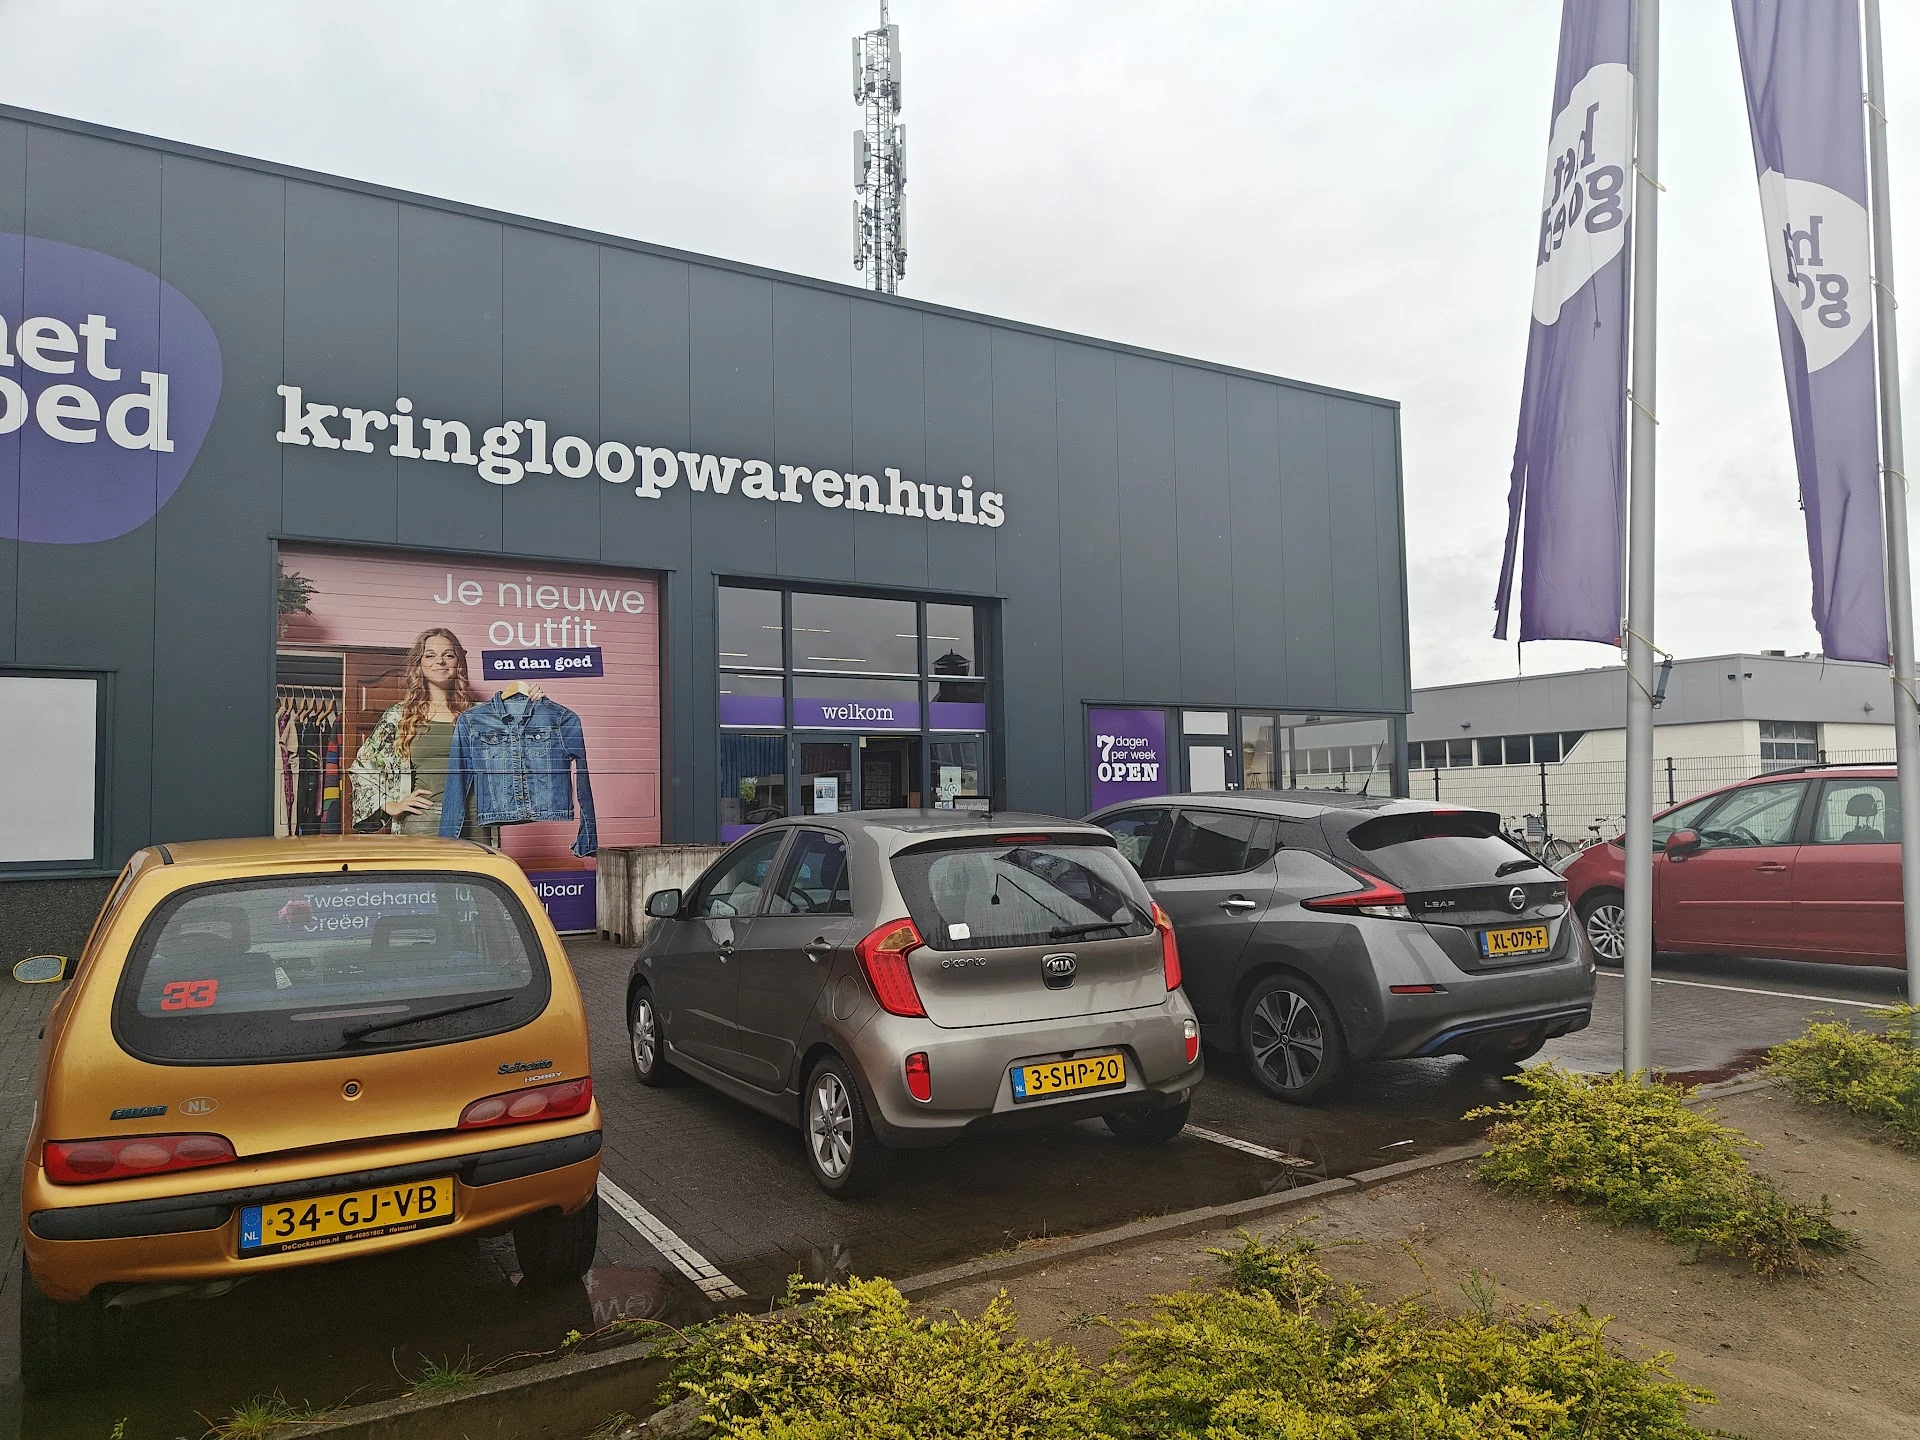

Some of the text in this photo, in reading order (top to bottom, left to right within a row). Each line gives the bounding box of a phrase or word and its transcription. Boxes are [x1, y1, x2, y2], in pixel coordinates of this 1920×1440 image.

[0, 314, 121, 381] et
[276, 384, 1006, 528] kringloopwarenhuis
[433, 573, 645, 614] Je nieuwe
[488, 615, 597, 648] outfit
[494, 655, 593, 672] en dan goed
[821, 703, 895, 721] welkom
[1096, 734, 1149, 763] 7 dagen
[1111, 749, 1157, 763] per week
[1097, 762, 1160, 782] OPEN
[1424, 900, 1456, 908] LEAF
[1492, 929, 1544, 950] XL-079-F
[1051, 959, 1072, 973] KIA
[160, 979, 219, 1011] 33
[524, 1071, 562, 1083] HOBBY
[1031, 1059, 1119, 1091] 3-SHP-20
[1015, 1085, 1025, 1093] NL
[114, 1106, 166, 1118] FIAT
[187, 1099, 211, 1113] NL
[275, 1185, 438, 1237] 34-GJ-VB
[243, 1231, 259, 1242] NL
[281, 1236, 340, 1251] DeCockautos.nl
[389, 1223, 417, 1234] Helmond
